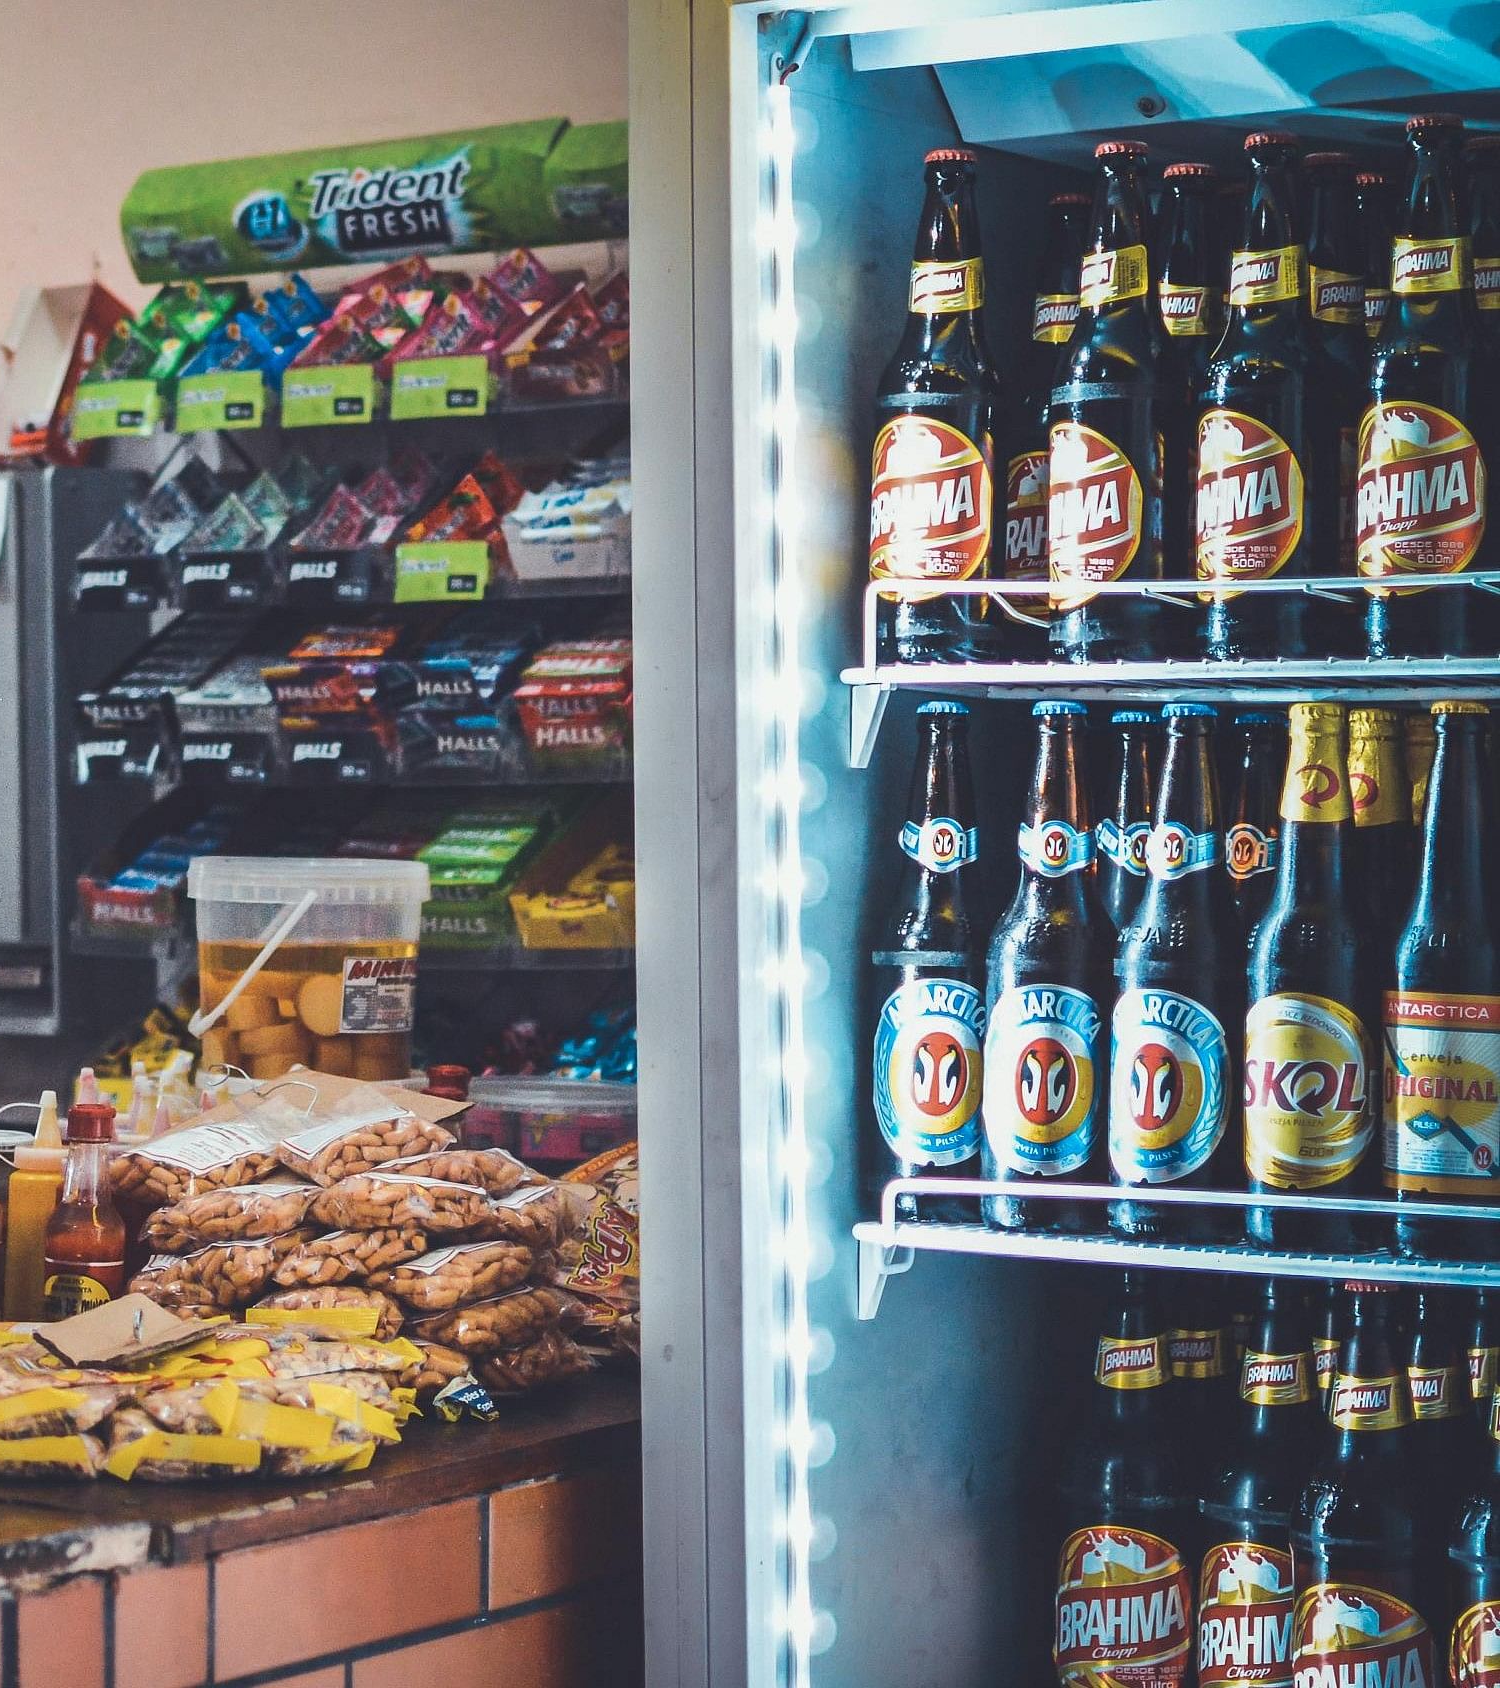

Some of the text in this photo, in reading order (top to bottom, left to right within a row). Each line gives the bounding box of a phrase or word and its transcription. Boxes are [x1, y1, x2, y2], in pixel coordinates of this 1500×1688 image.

[311, 159, 466, 215] Trident
[344, 208, 440, 240] FRESH
[1378, 518, 1418, 535] Chopp
[1395, 541, 1432, 549] DESDE
[1232, 558, 1266, 569] 600ml
[1417, 553, 1454, 565] 600ml
[416, 681, 473, 697] HALLS
[438, 735, 501, 752] HALLS
[536, 726, 606, 747] HALLS
[1388, 1002, 1490, 1019] ANTARCTICA
[1402, 1049, 1463, 1066] Cerveja
[1244, 1060, 1367, 1119] SKOL
[1385, 1067, 1499, 1104] ORIGINAL
[1413, 1121, 1440, 1131] PILSEN
[1105, 1348, 1153, 1371] BRAHMA
[1248, 1363, 1294, 1384] BRAHMA
[1058, 1584, 1185, 1652] BRAHMA
[1092, 1644, 1138, 1660] Chopp
[1226, 1665, 1271, 1679] Chopp
